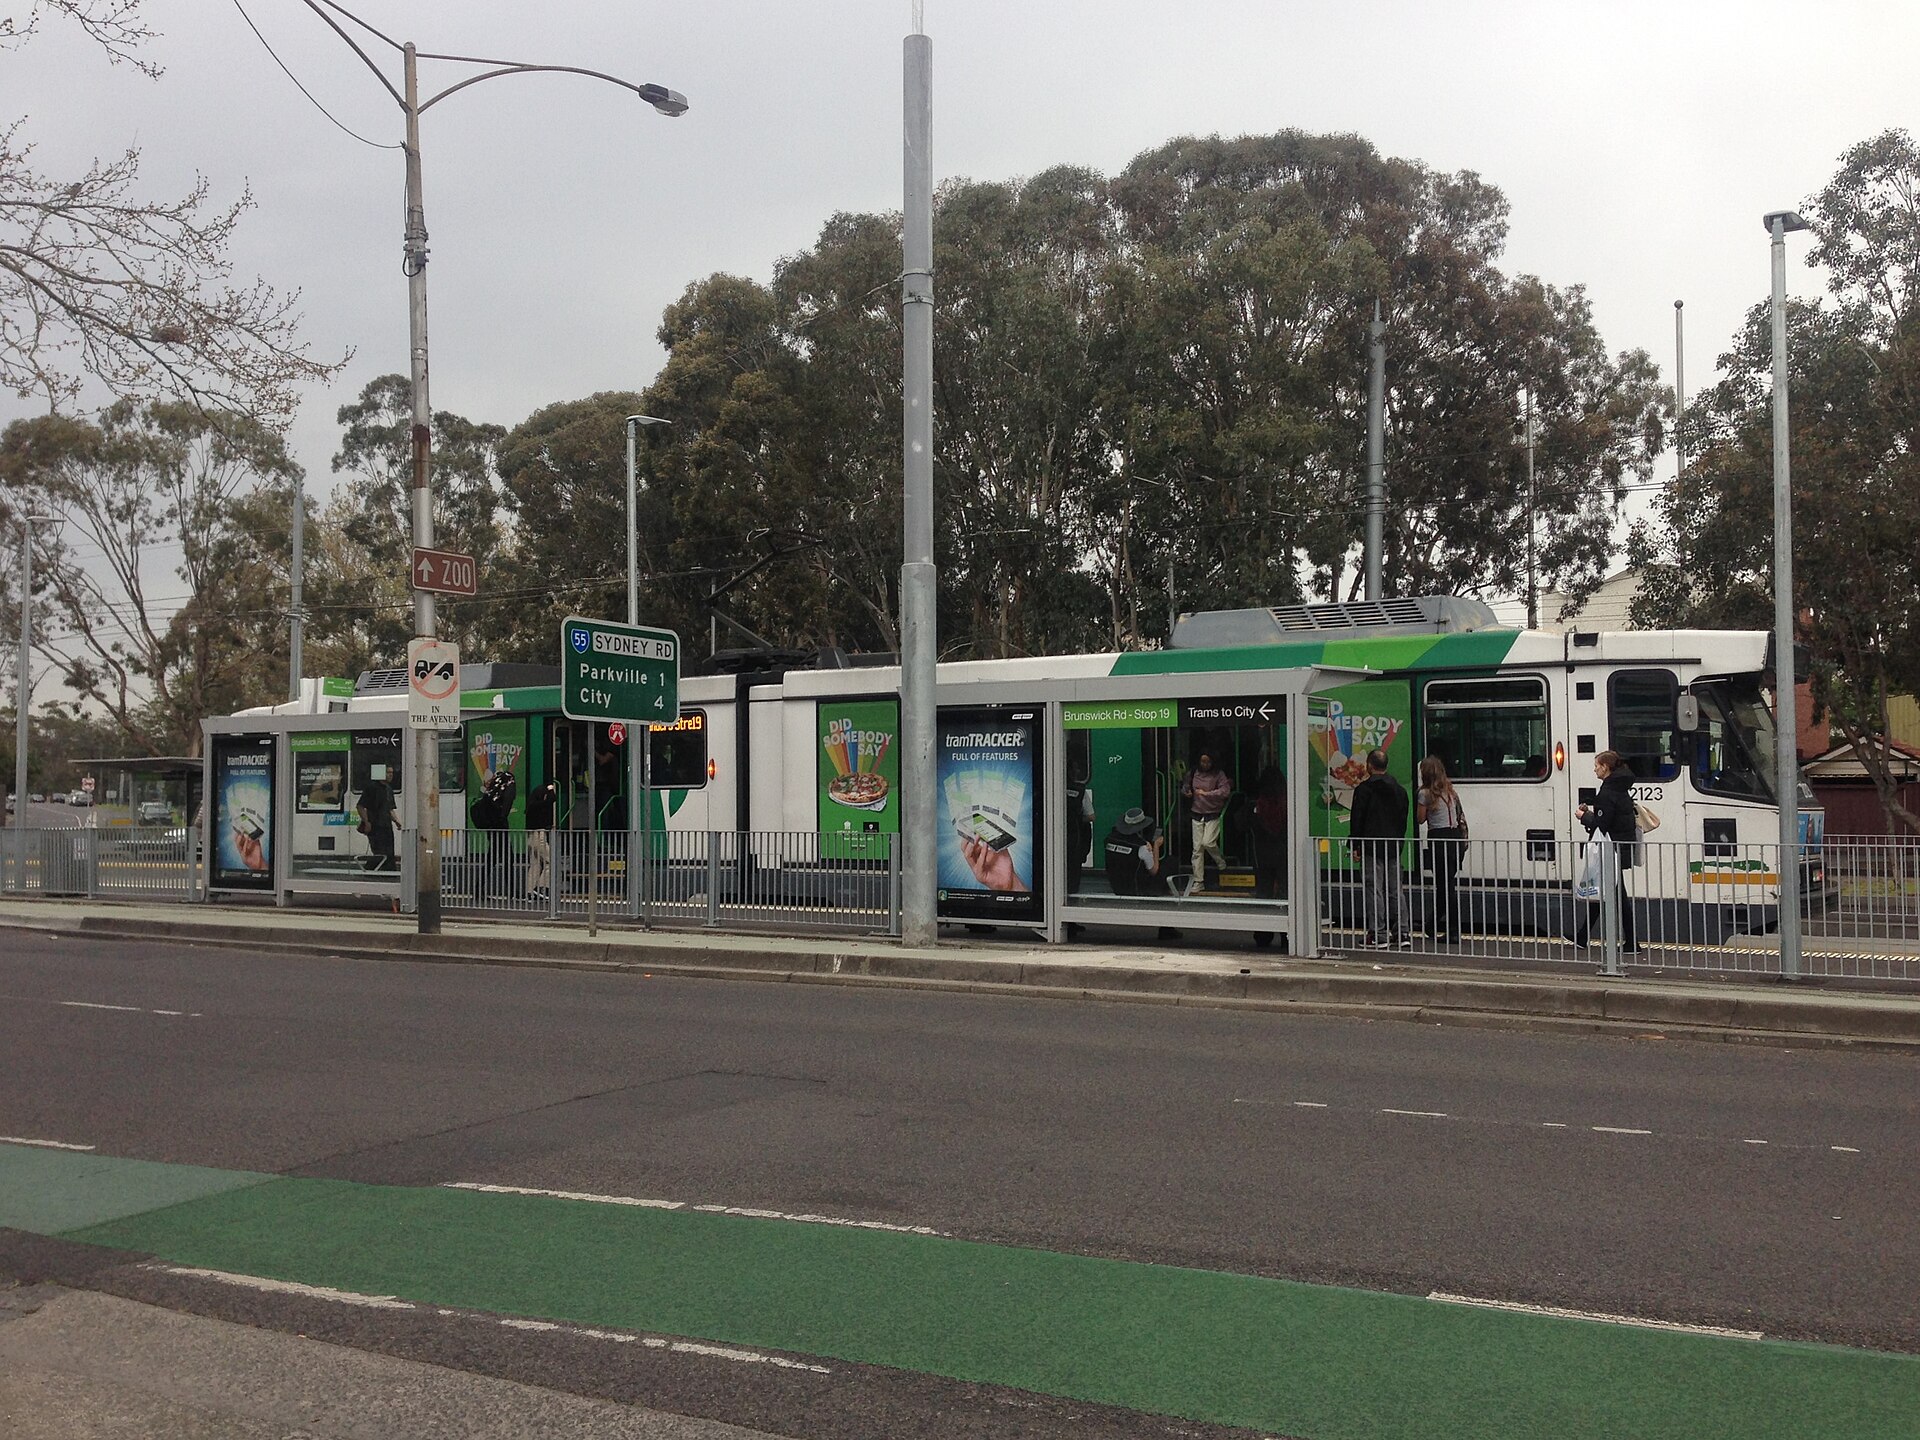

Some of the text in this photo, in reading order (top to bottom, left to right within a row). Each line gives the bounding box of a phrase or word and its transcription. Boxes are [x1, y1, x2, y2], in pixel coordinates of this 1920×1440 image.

[442, 560, 471, 588] ZOO
[574, 633, 587, 646] 55
[595, 635, 672, 658] SYDNEY RD
[580, 663, 665, 687] Parkville 1
[580, 687, 664, 710] City 4
[431, 705, 440, 713] IN
[1064, 710, 1111, 721] Brunswick
[1113, 710, 1127, 720] Rd
[1134, 708, 1157, 721] Stop
[1159, 708, 1170, 719] 19
[1188, 706, 1255, 719] Trams to City
[411, 715, 458, 724] THE AVENUE
[829, 718, 852, 733] DID
[355, 736, 371, 744] Trams
[378, 735, 390, 745] City
[475, 732, 492, 745] DID
[823, 731, 893, 747] SOMEBODY
[1352, 731, 1388, 746] SAY
[470, 743, 522, 757] SOMEBODY
[858, 744, 883, 757] SAY
[982, 752, 1018, 760] FEATURES
[496, 754, 515, 765] SAY
[1629, 787, 1663, 801] 2123
